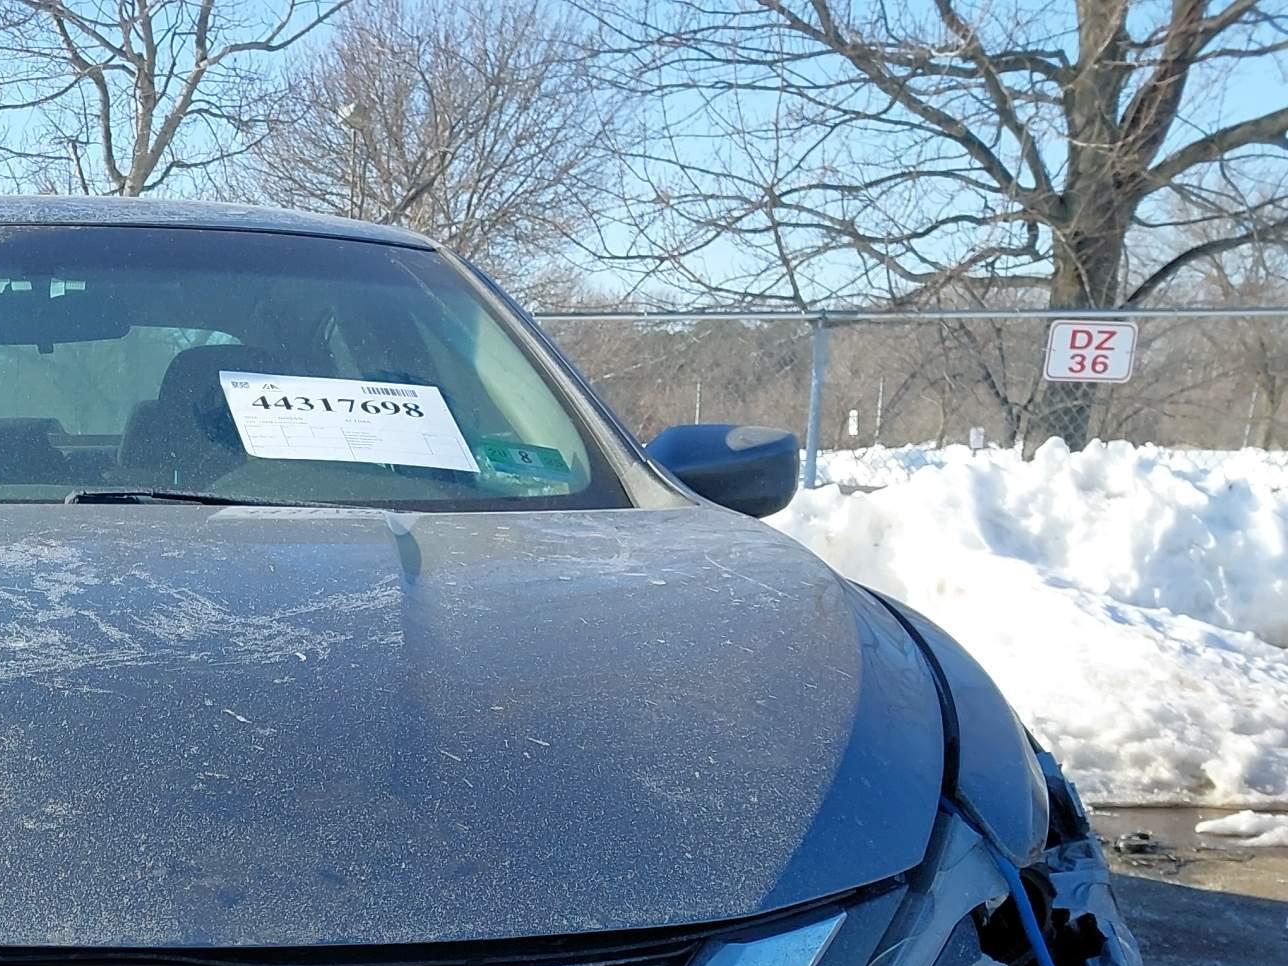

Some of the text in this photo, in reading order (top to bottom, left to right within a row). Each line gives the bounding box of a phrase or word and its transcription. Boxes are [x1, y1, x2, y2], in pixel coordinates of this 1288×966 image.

[1069, 329, 1117, 351] DZ
[1068, 353, 1109, 374] 36
[252, 394, 425, 419] 44317698
[518, 450, 533, 464] 8
